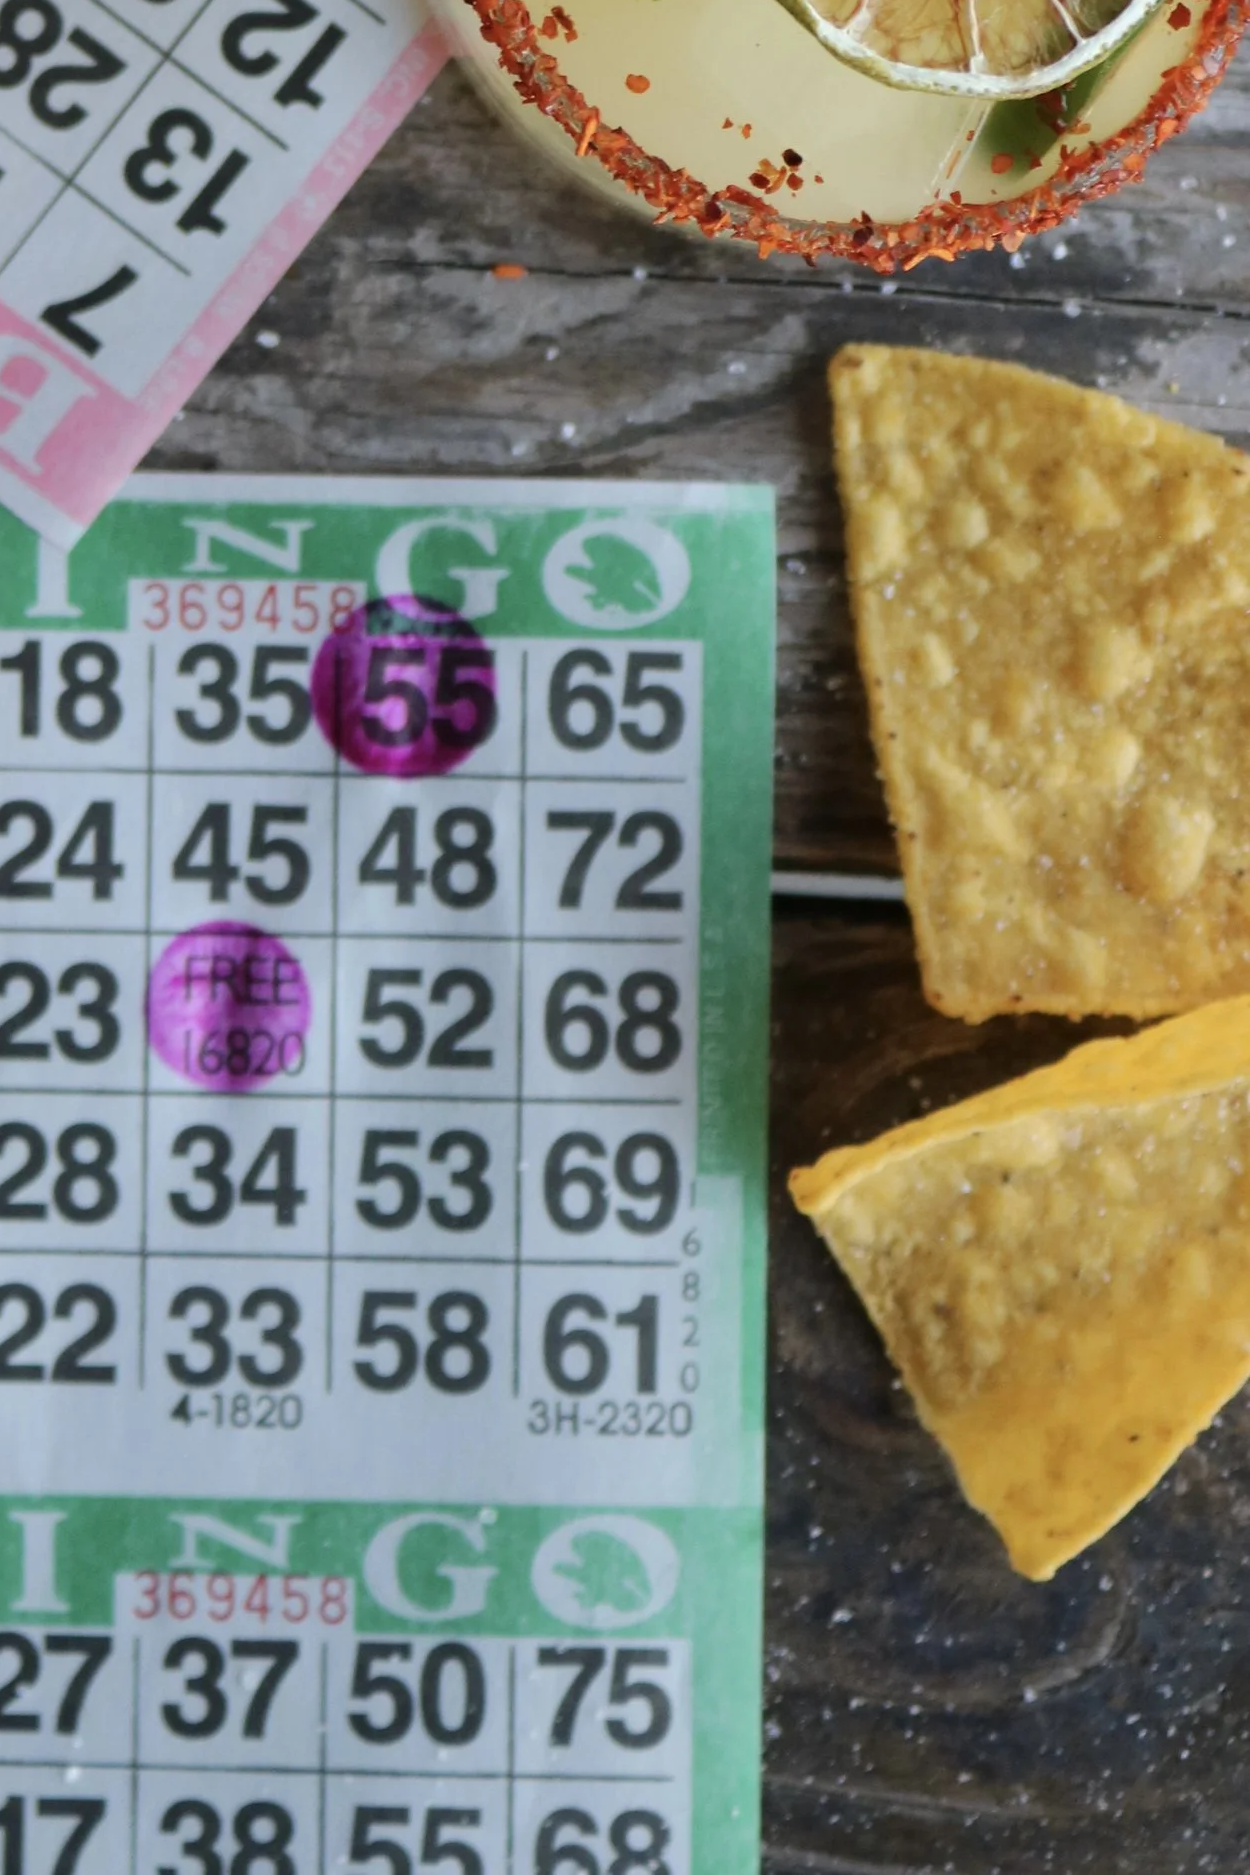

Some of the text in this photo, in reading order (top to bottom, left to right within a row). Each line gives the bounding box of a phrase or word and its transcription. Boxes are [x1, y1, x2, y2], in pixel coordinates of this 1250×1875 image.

[123, 106, 250, 235] 13
[39, 262, 137, 357] 7
[143, 580, 359, 634] 369458
[173, 642, 313, 745] 35
[361, 649, 498, 749] 55
[548, 648, 685, 753] 65
[173, 803, 310, 906] 45
[359, 806, 497, 911] 48
[547, 810, 684, 912] 72
[183, 957, 302, 1005] FREE
[360, 967, 494, 1069] 52
[545, 970, 683, 1074] 68
[182, 1030, 307, 1077] 16820
[169, 1124, 306, 1226] 34
[356, 1129, 493, 1232] 53
[543, 1131, 681, 1234] 69
[166, 1286, 305, 1389] 33
[353, 1289, 491, 1394] 58
[543, 1293, 658, 1396] 61
[168, 1396, 305, 1430] 4-1820
[527, 1401, 695, 1437] 3H-2320
[133, 1572, 350, 1625] 369458
[166, 1636, 299, 1739] 37
[352, 1641, 486, 1745] 50
[536, 1645, 673, 1749] 75
[158, 1801, 295, 1875] 38
[349, 1806, 483, 1875] 55
[536, 1807, 673, 1875] 68
